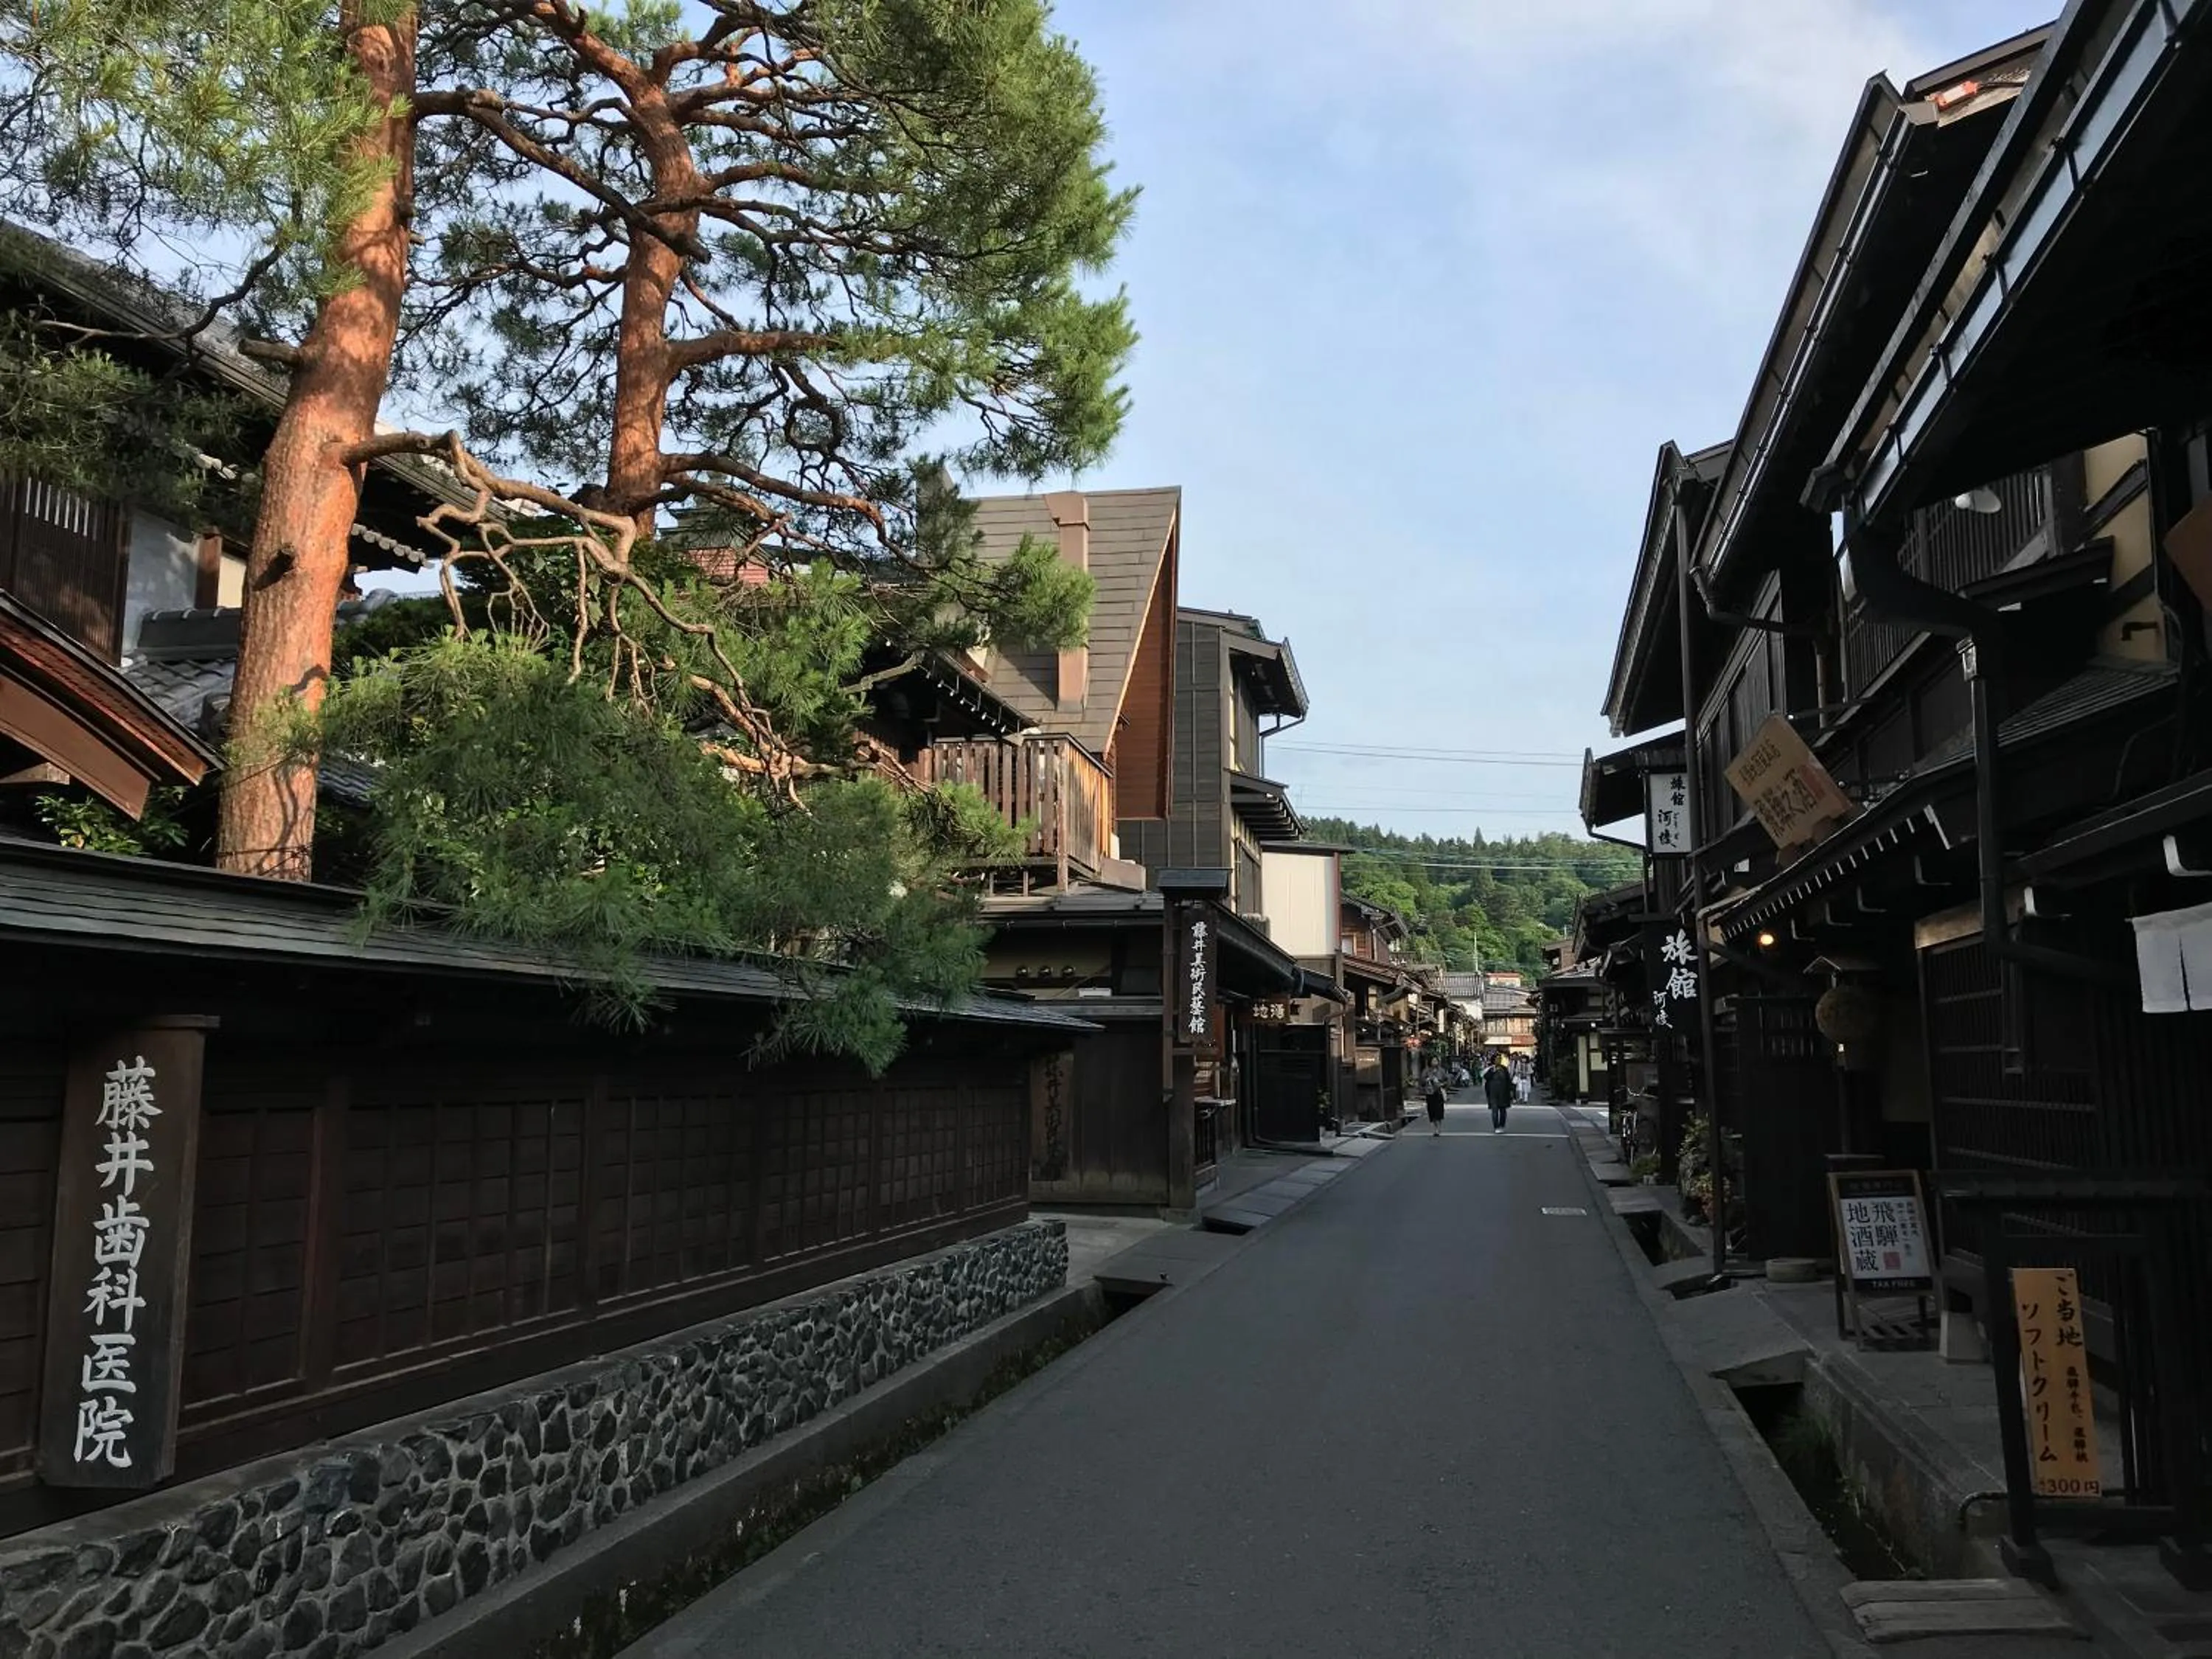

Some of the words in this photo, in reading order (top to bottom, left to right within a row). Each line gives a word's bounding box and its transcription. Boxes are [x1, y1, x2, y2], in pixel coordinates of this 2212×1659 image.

[1660, 928, 1698, 1000] 旅館
[1847, 1201, 1879, 1273] 地酒蔵
[1872, 1201, 1899, 1247] 飛騨
[74, 1055, 163, 1468] 藤井歯科医院
[2054, 1273, 2083, 1347] ご当地
[2022, 1302, 2057, 1461] ソフトクリーム
